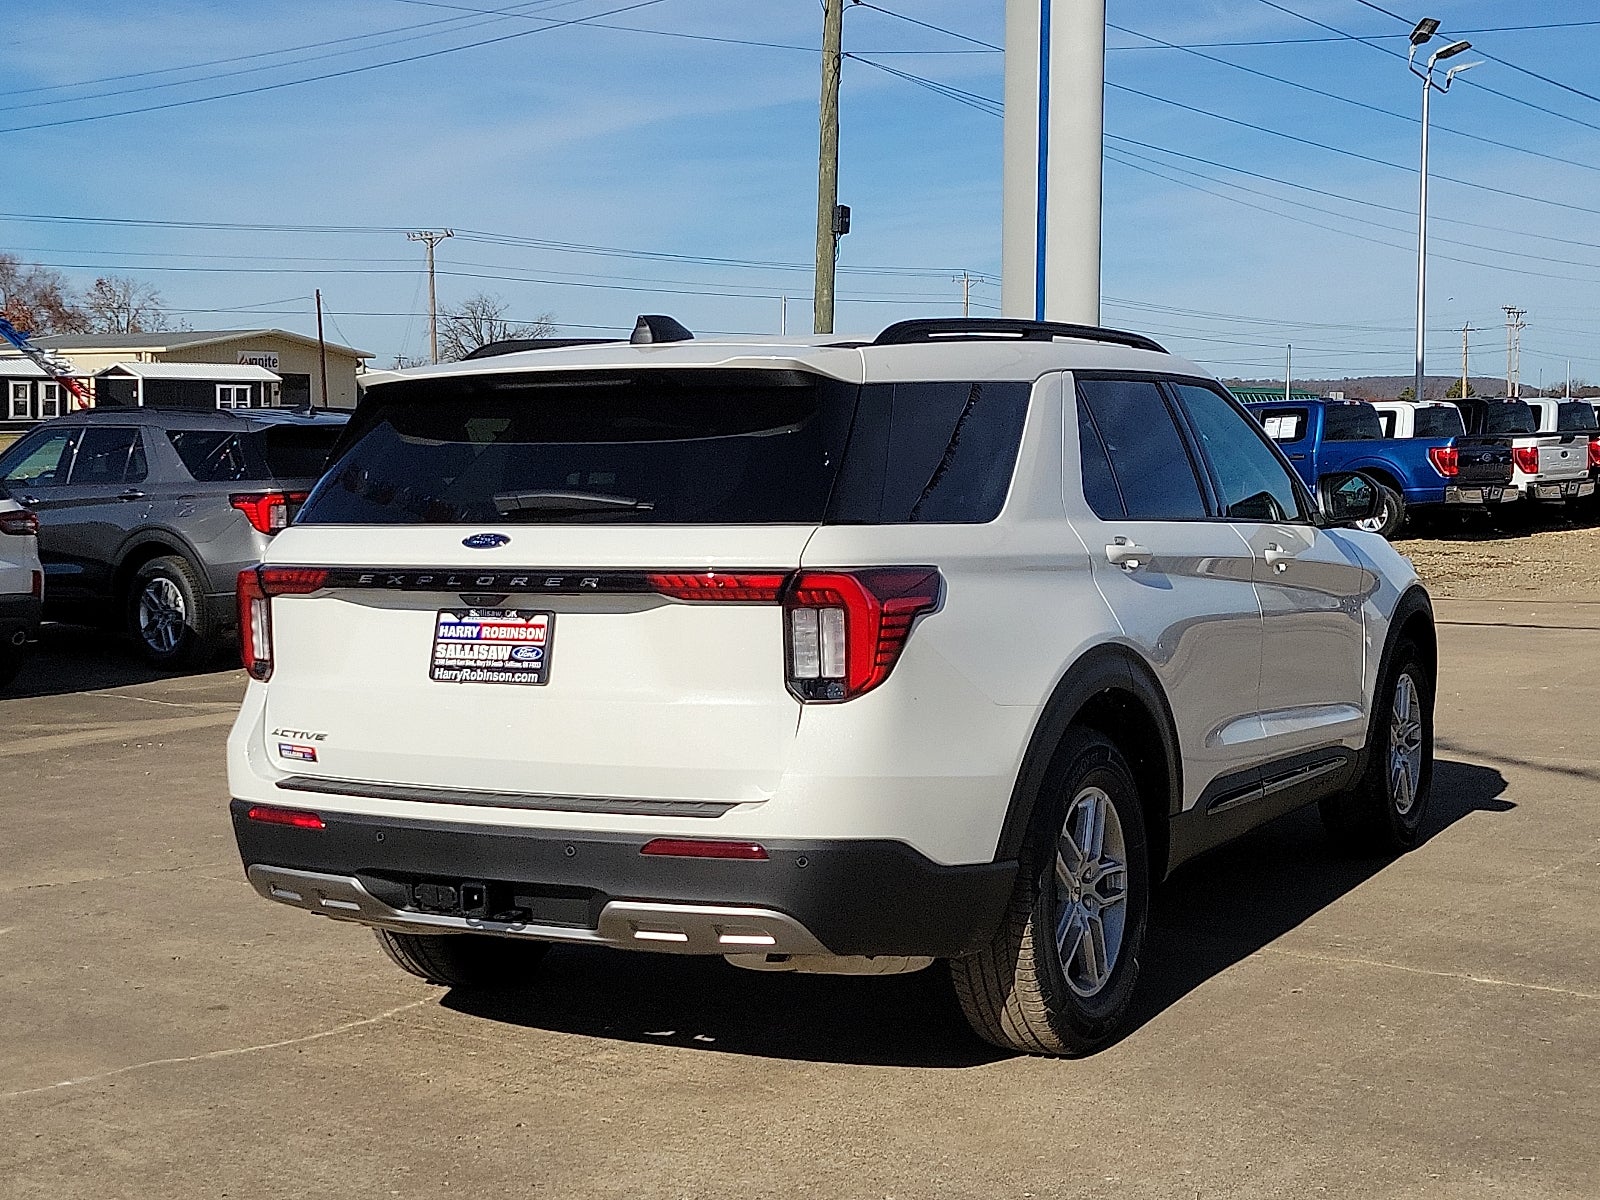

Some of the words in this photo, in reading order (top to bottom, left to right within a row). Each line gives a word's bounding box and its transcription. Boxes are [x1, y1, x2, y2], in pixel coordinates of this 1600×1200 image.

[358, 574, 599, 588] EXPLORER
[505, 609, 517, 618] OK
[438, 625, 480, 638] HARRY
[481, 626, 545, 640] ROBINSON
[435, 643, 512, 660] SALLISAW
[434, 667, 538, 682] HarryRobinson.com
[271, 728, 328, 741] ACTIVE
